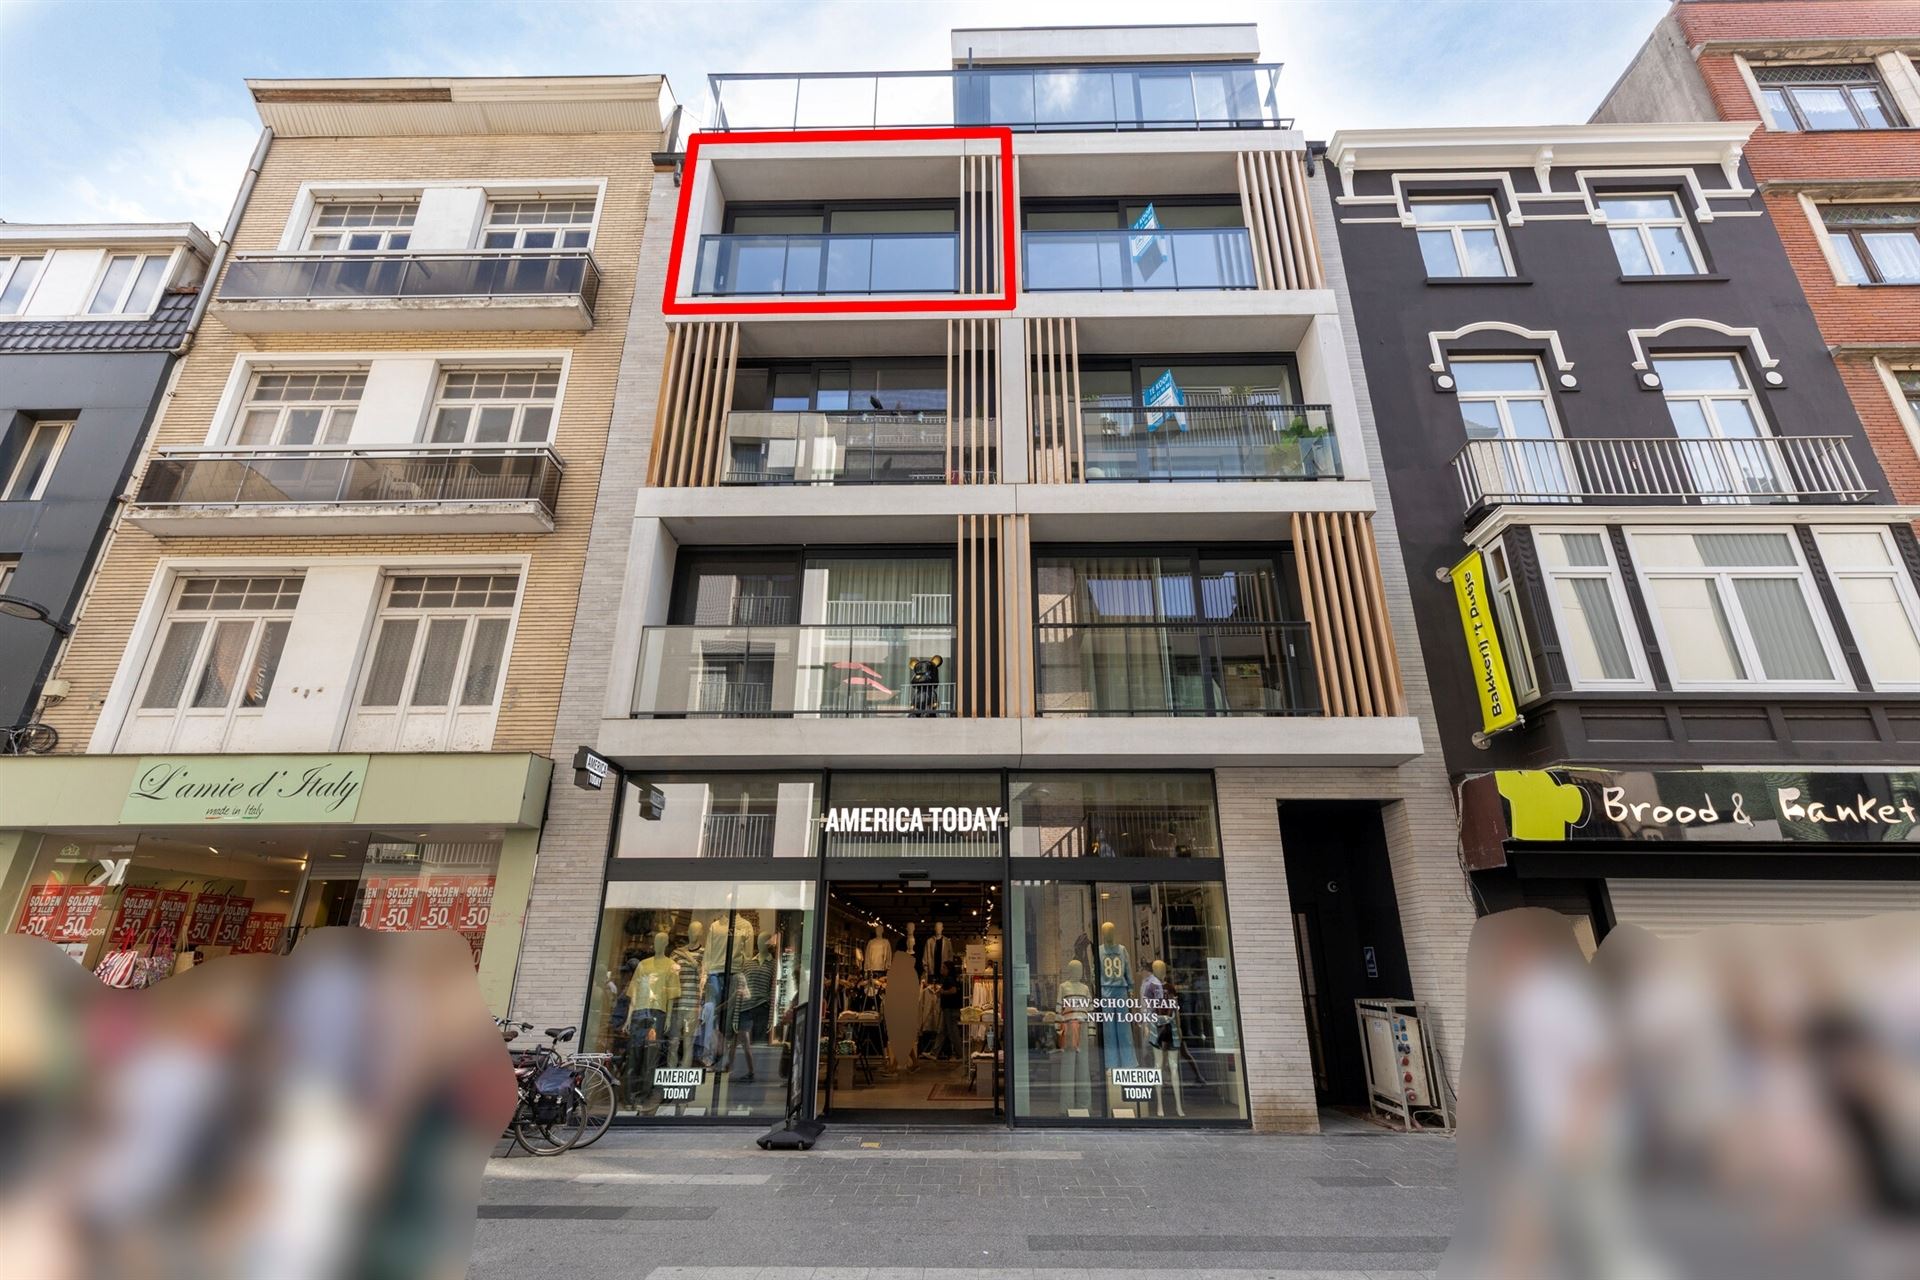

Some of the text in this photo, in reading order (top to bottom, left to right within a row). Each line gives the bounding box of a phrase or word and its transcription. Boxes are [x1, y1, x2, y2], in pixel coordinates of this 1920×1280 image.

[1465, 572, 1479, 619] Putje
[1479, 639, 1502, 717] Bakkerij
[129, 763, 244, 800] L'amie
[277, 763, 359, 813] Italy
[206, 803, 264, 819] made in Italy
[1603, 787, 1719, 823] Brood
[1731, 792, 1754, 828] &
[825, 807, 1002, 832] AMERICA TODAY
[387, 888, 419, 898] SOLDEN
[427, 887, 459, 897] SOLDEN
[467, 887, 493, 897] SOLDE
[30, 896, 62, 907] SOLDEN
[67, 896, 100, 907] SOLDEN
[124, 898, 153, 909] SOLDEN
[1103, 957, 1123, 978] 89
[1063, 998, 1180, 1010] NEW SCHOOL YEAR,
[1087, 1012, 1158, 1023] NEW LOOKS
[656, 1070, 700, 1083] AMERICA
[1115, 1070, 1160, 1083] AMERICA
[663, 1087, 691, 1099] TODAY
[1124, 1087, 1153, 1099] TODAY
